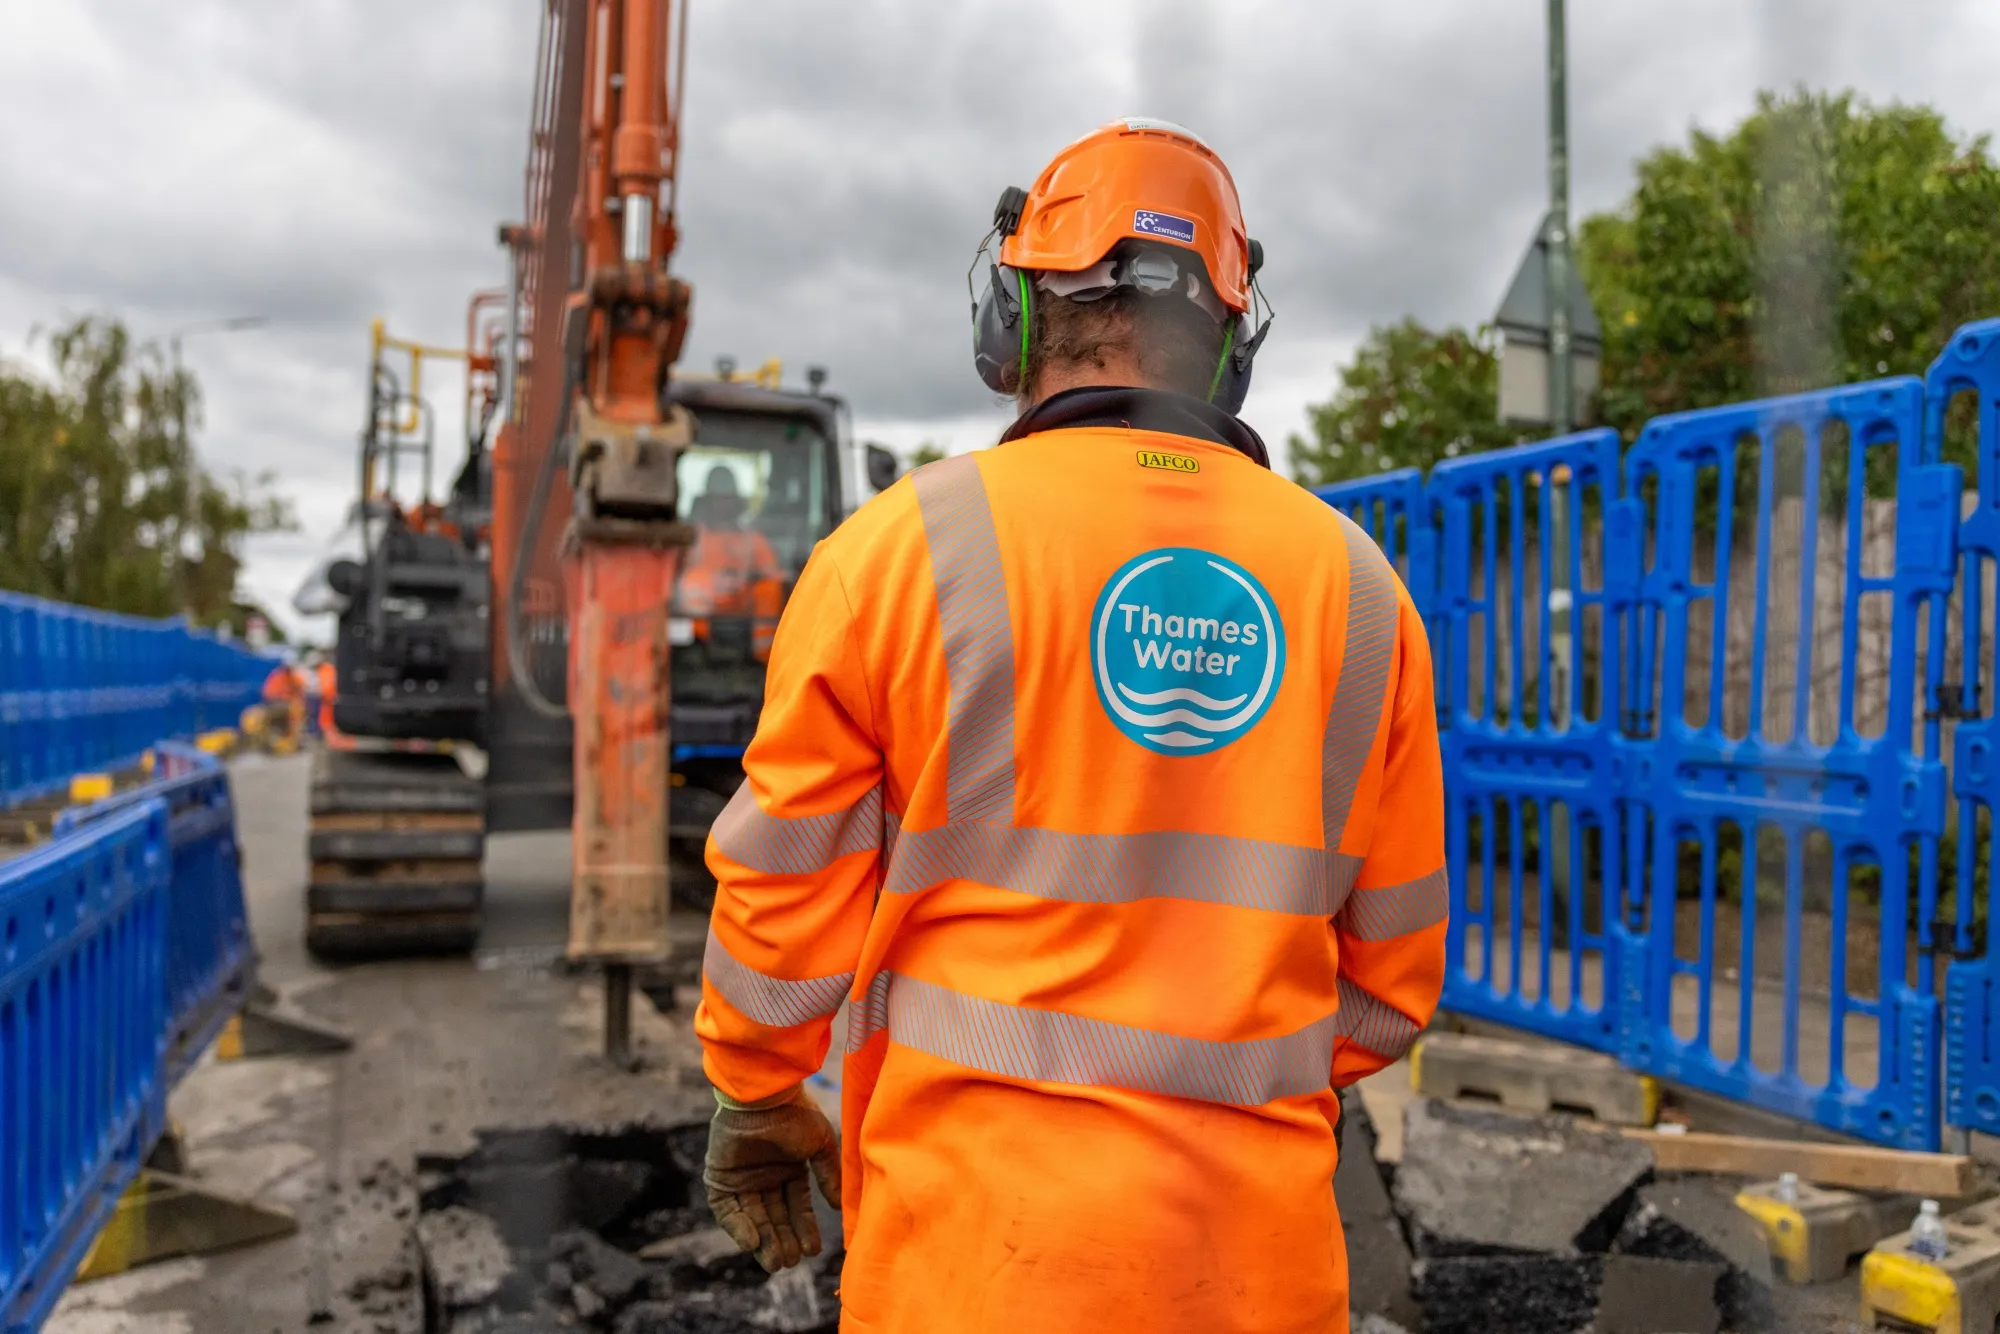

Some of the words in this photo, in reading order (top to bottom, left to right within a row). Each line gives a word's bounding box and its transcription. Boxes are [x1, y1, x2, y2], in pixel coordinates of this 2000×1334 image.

[1153, 226, 1191, 240] CENTURION
[1142, 453, 1196, 471] JAFCO
[1118, 603, 1259, 646] Thames
[1133, 638, 1241, 676] Water
